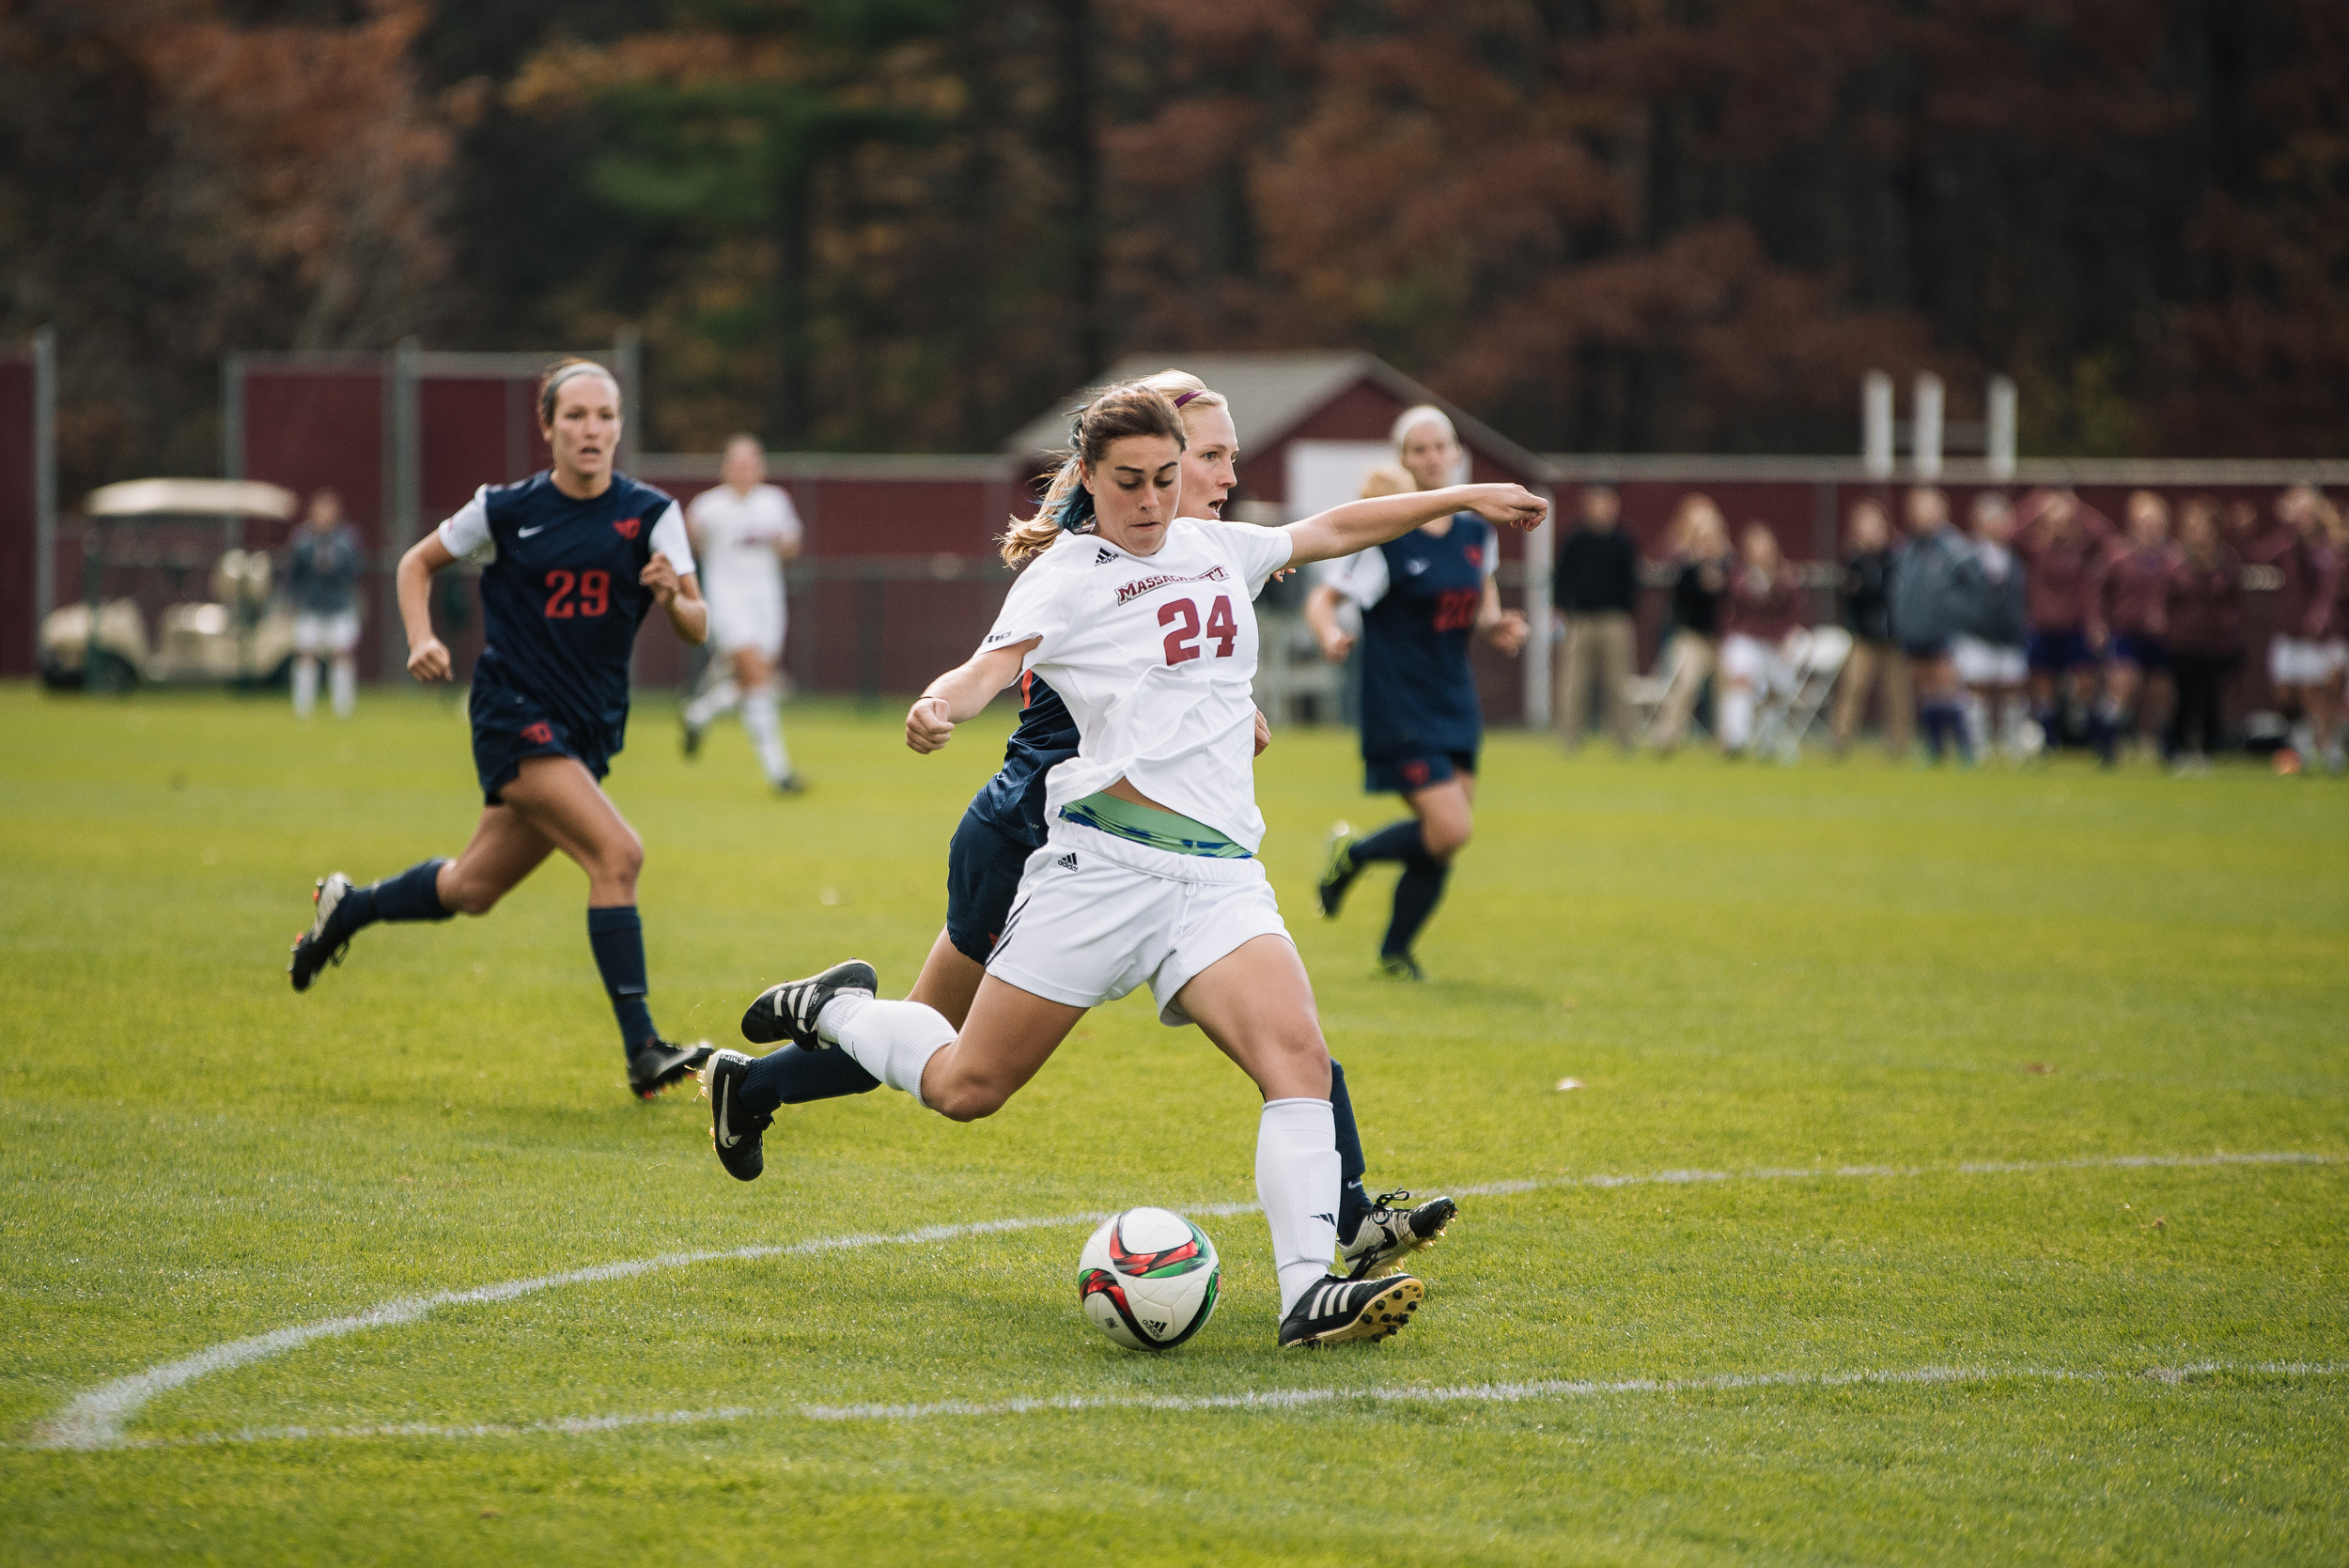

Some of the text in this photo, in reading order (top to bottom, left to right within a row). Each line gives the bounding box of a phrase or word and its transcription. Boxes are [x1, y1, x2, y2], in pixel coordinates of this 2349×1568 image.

[545, 568, 611, 618] 29
[1157, 596, 1238, 666] 24
[1058, 860, 1079, 873] adidas
